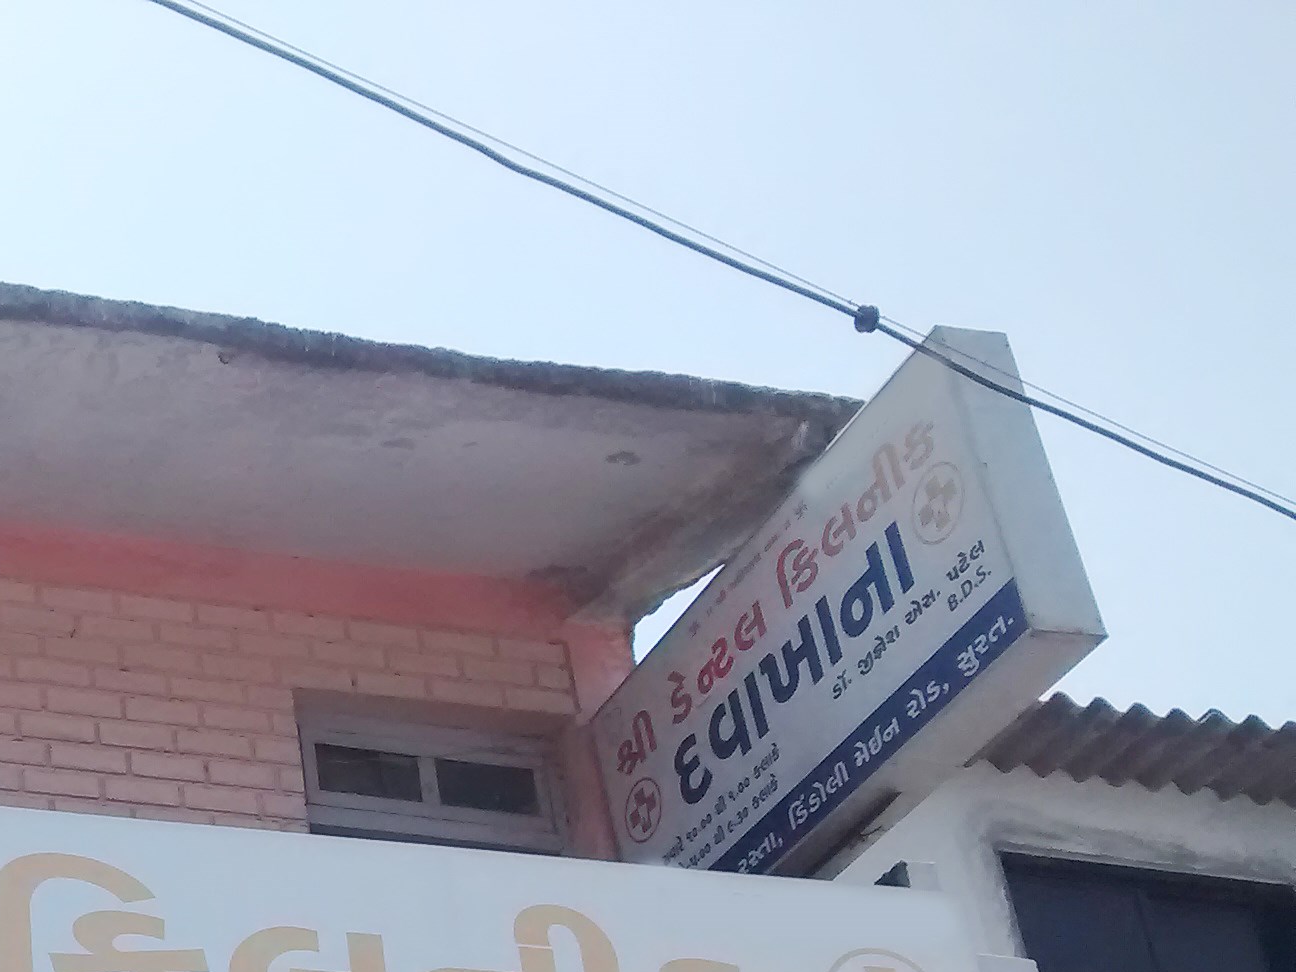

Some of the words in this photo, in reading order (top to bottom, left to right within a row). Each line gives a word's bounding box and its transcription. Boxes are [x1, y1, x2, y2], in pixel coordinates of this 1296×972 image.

[946, 540, 985, 582] પટેલ
[947, 565, 992, 612] B.D.S.
[674, 521, 916, 804] દવાખાના
[617, 710, 657, 774] શ્રી
